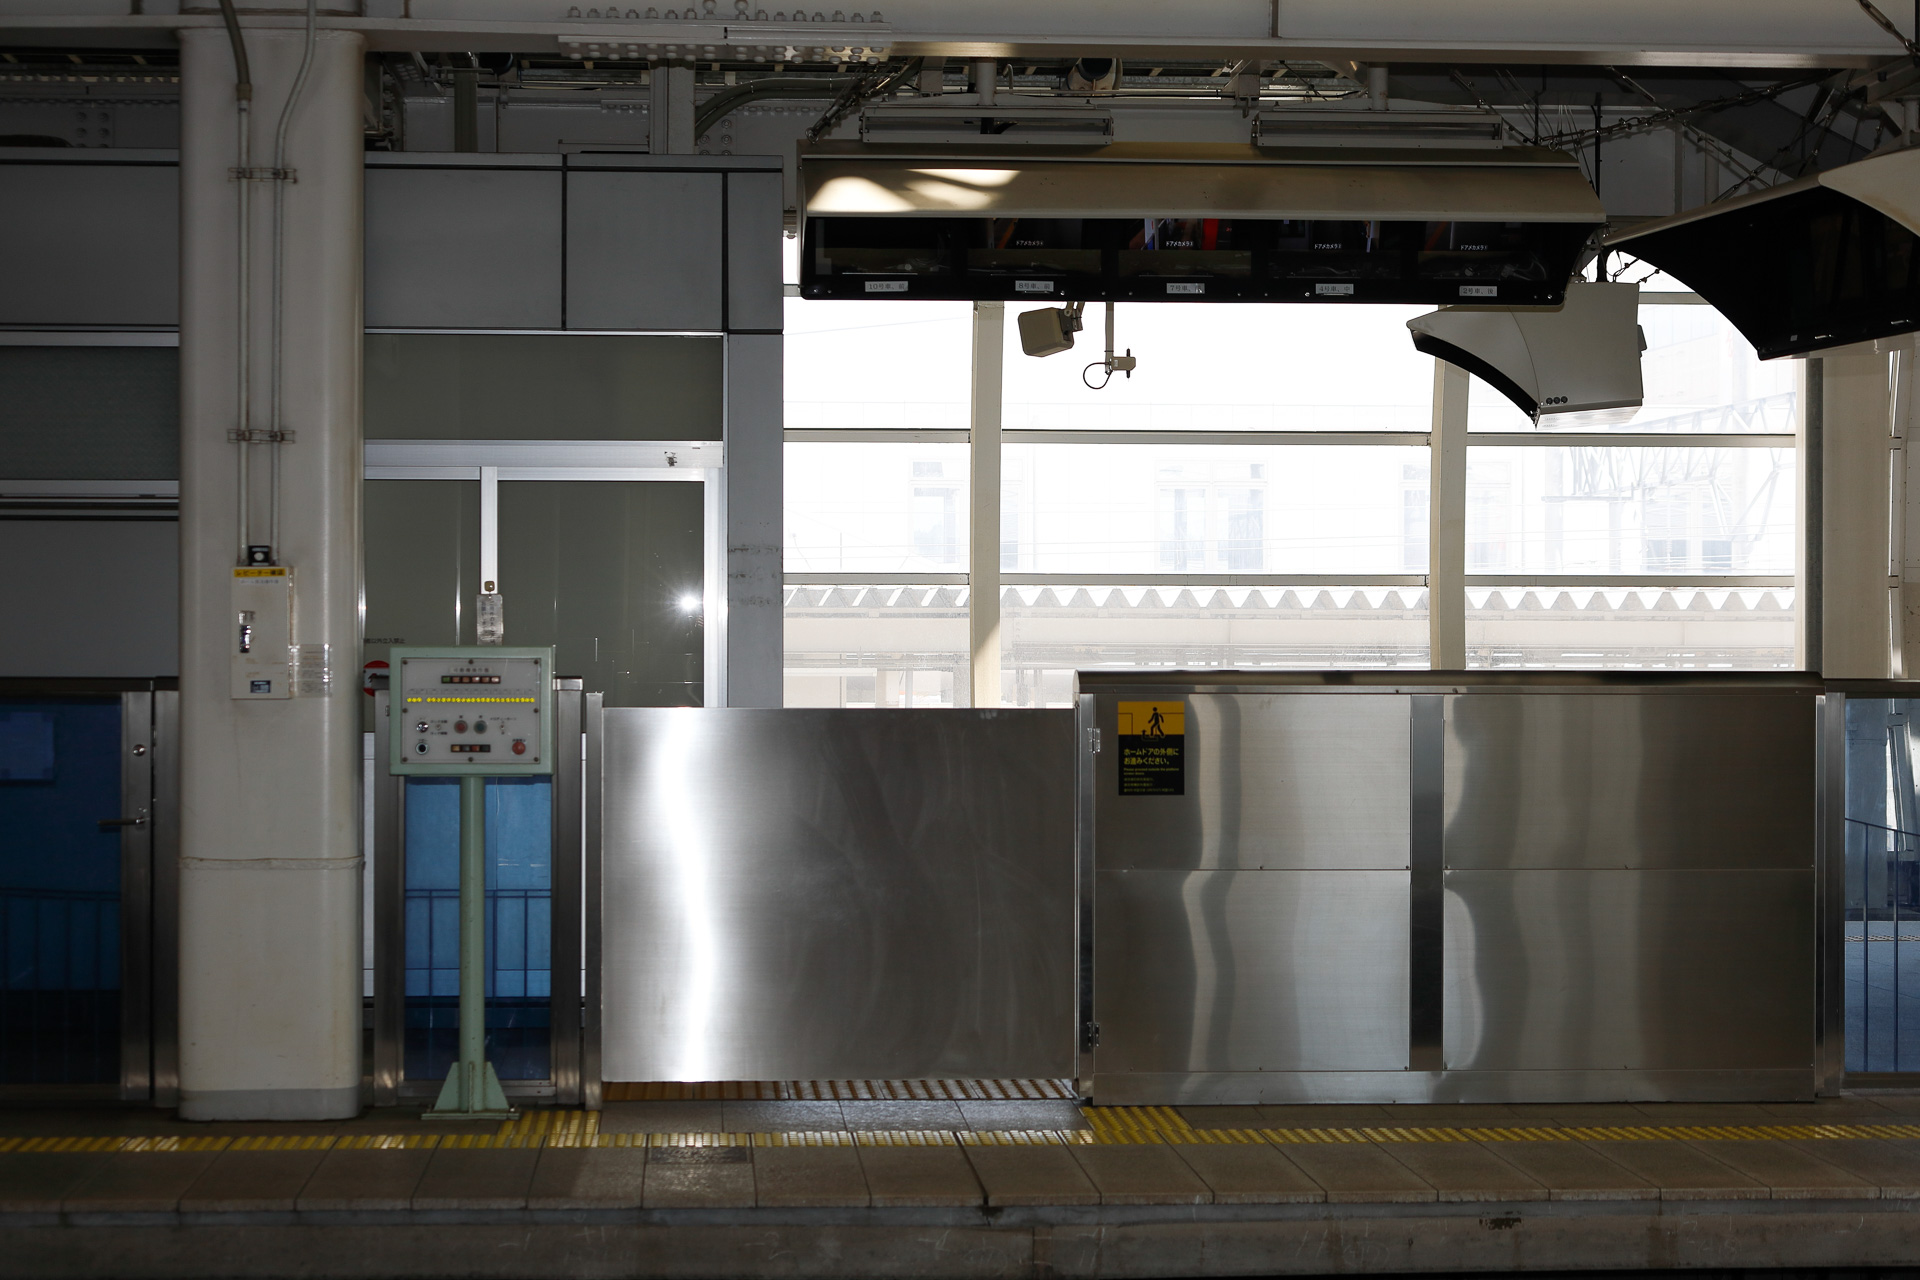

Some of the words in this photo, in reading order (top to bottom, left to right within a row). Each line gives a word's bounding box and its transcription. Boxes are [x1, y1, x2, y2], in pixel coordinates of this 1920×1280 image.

[1123, 748, 1180, 756] ホームドアの外側に
[1123, 757, 1170, 765] お進みください。
